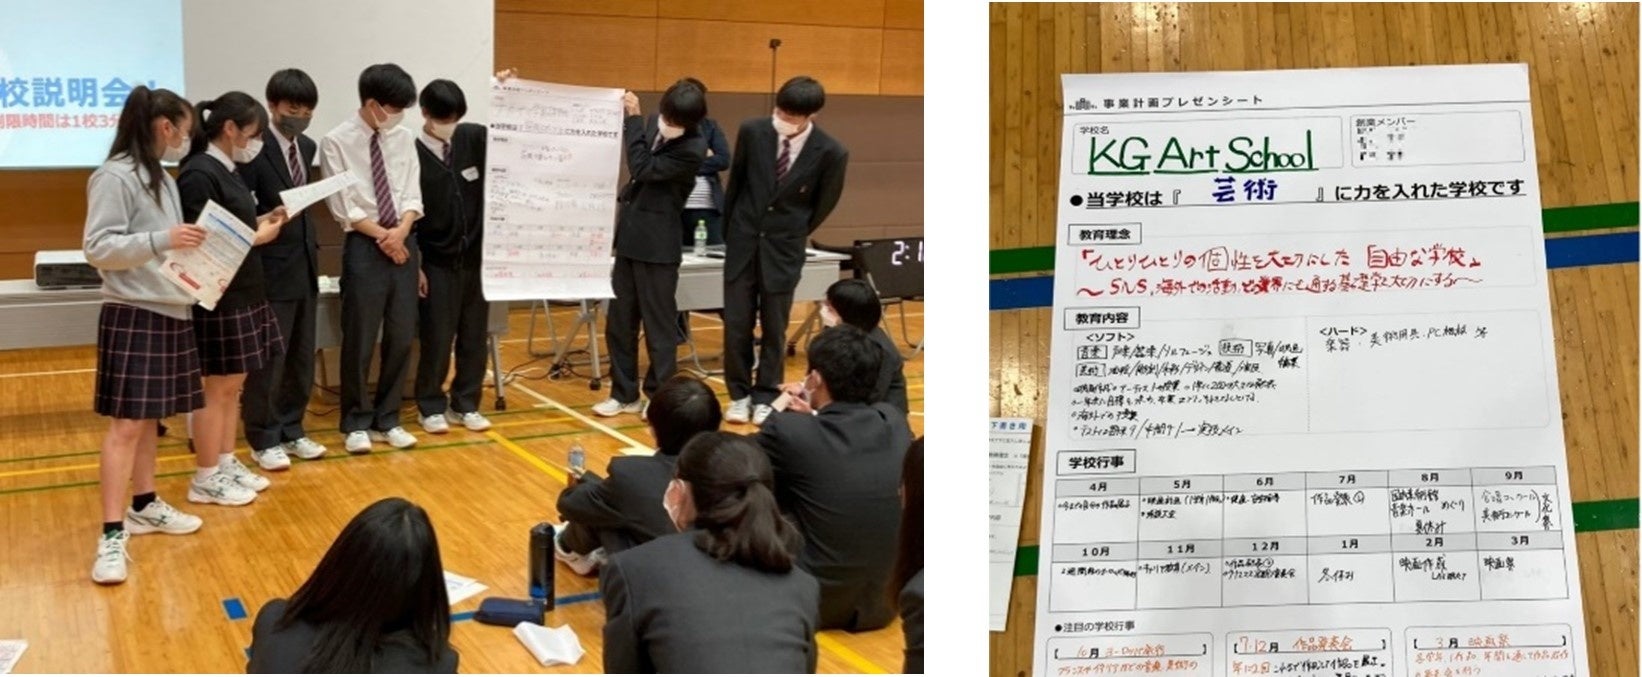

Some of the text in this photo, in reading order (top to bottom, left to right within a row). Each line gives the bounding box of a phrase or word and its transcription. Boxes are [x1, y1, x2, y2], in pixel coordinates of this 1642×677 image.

[1103, 95, 1263, 109] 事業計画プレゼンシート
[1356, 117, 1416, 127] 創業メンバー
[1079, 126, 1110, 135] 学校名
[1088, 136, 1151, 175] KG
[1154, 137, 1220, 173] Art
[1223, 130, 1319, 173] School
[1212, 176, 1278, 203] 芸術
[1079, 228, 1131, 241] 教育理念
[1075, 312, 1129, 324] 教育内容
[1069, 456, 1124, 469] 学校行事
[1339, 475, 1356, 484] 7月
[1421, 473, 1439, 482] 8月
[1505, 471, 1523, 480] 9月
[1089, 482, 1107, 491] 4月
[1174, 480, 1191, 489] 5月
[1257, 477, 1274, 486] 6月
[1342, 539, 1358, 549] 1月
[1426, 537, 1443, 547] 2月
[1511, 535, 1529, 545] 3月
[1083, 547, 1110, 556] 10月
[1168, 545, 1195, 553] 11月
[1252, 542, 1279, 551] 12月
[1063, 621, 1135, 632] 注目の学校行事
